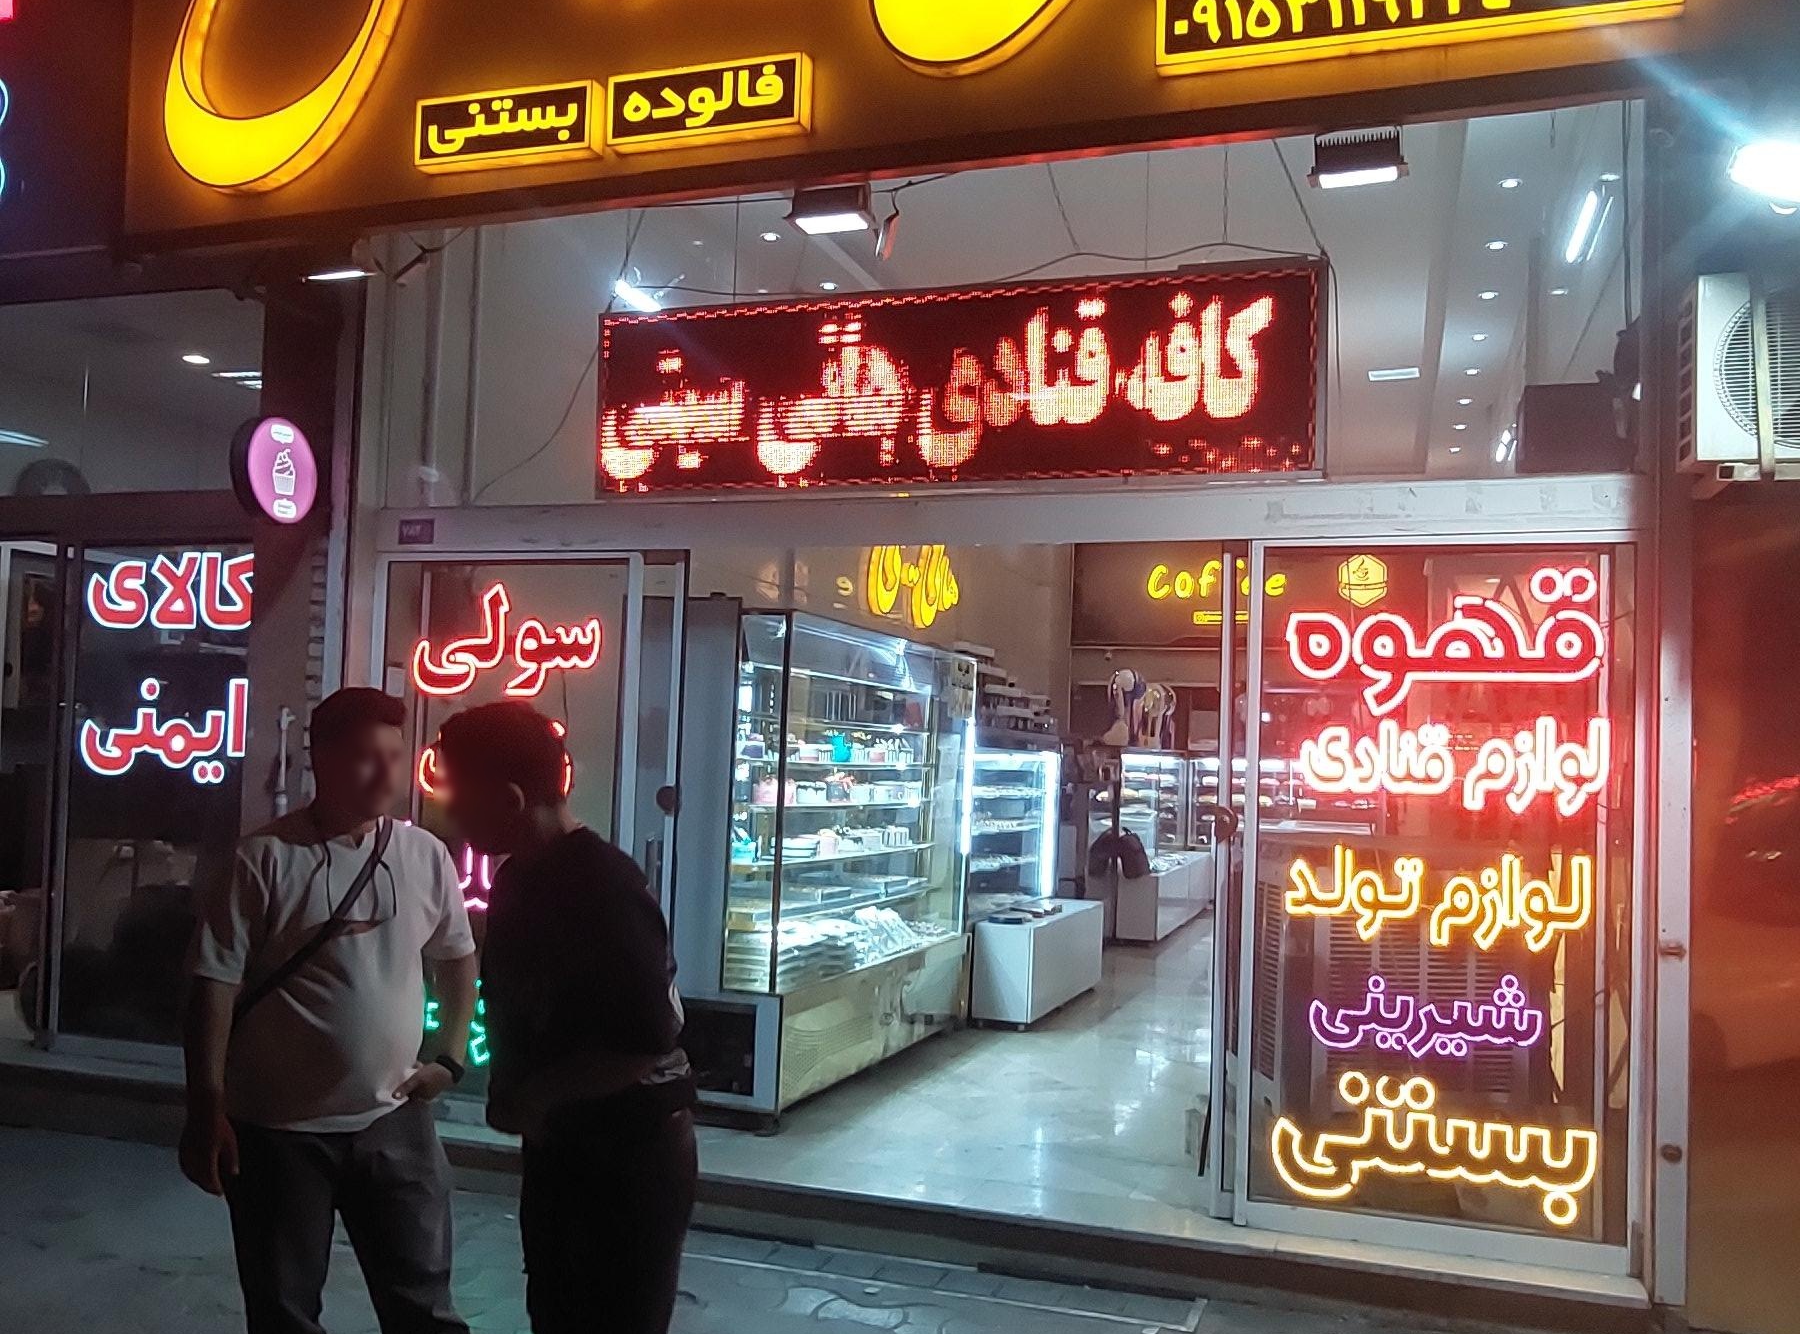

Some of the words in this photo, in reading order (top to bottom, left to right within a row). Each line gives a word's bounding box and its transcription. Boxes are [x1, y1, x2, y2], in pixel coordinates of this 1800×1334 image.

[427, 98, 578, 155] بستنی
[623, 64, 784, 128] فالوده
[917, 296, 1108, 467] قنادی
[1115, 291, 1274, 422] کافه
[87, 551, 255, 630] کالای
[1285, 566, 1605, 717] قهوه
[80, 677, 249, 784] ایمنی
[1300, 717, 1457, 796] قنادی
[1462, 715, 1611, 817] لوازم
[1284, 844, 1425, 944] تولد
[1428, 851, 1593, 953] لوازم
[1308, 973, 1544, 1058] شیرینی
[1270, 1069, 1600, 1227] بستنی
